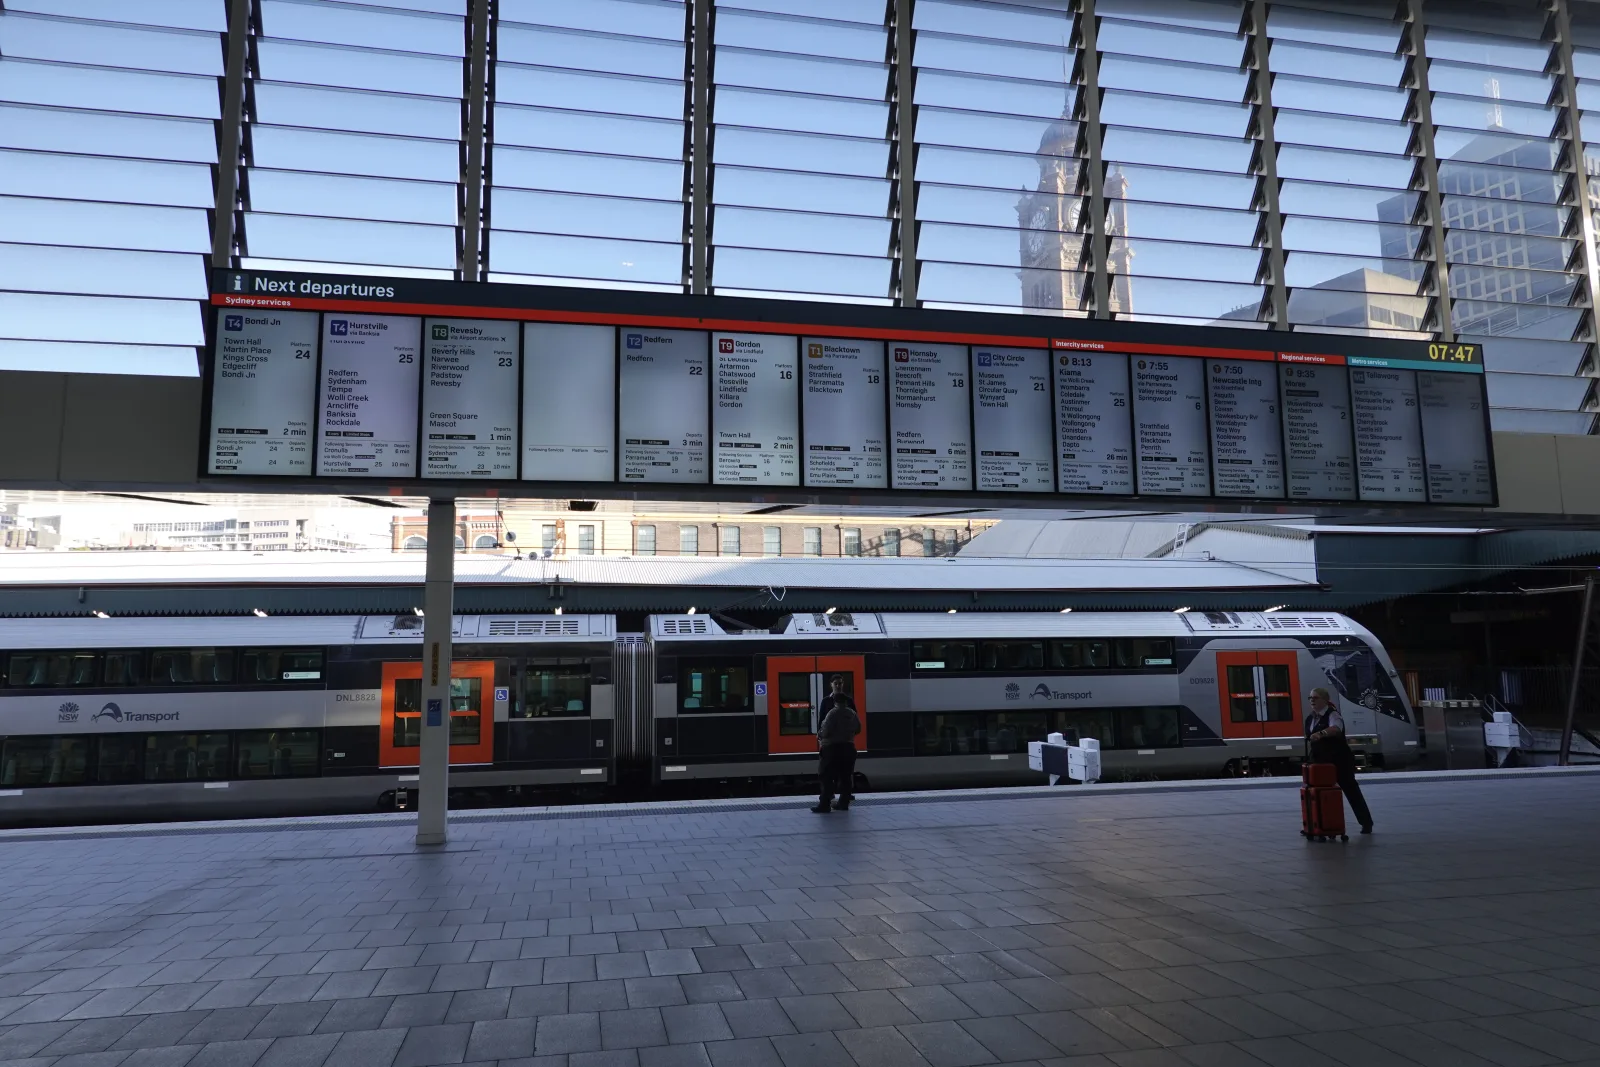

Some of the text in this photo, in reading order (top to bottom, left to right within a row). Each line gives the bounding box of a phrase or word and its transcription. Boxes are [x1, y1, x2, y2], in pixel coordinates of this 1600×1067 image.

[255, 277, 394, 298] Next departures
[225, 297, 256, 305] Sydney
[227, 319, 240, 327] T4
[333, 324, 346, 332] T4
[720, 342, 732, 350] T9
[296, 350, 310, 359] 24
[810, 347, 821, 355] T1
[1429, 344, 1474, 361] 07:47
[399, 354, 413, 363] 25
[499, 358, 512, 366] 23
[1072, 358, 1091, 366] 8:13
[1149, 362, 1168, 370] 7:55
[1224, 366, 1243, 374] 7:50
[690, 367, 702, 375] 22
[780, 371, 792, 379] 16
[868, 376, 879, 384] 18
[1366, 372, 1399, 381] Tallawong
[1034, 383, 1045, 391] 21
[1052, 691, 1092, 700] Transport
[124, 711, 180, 722] Transport
